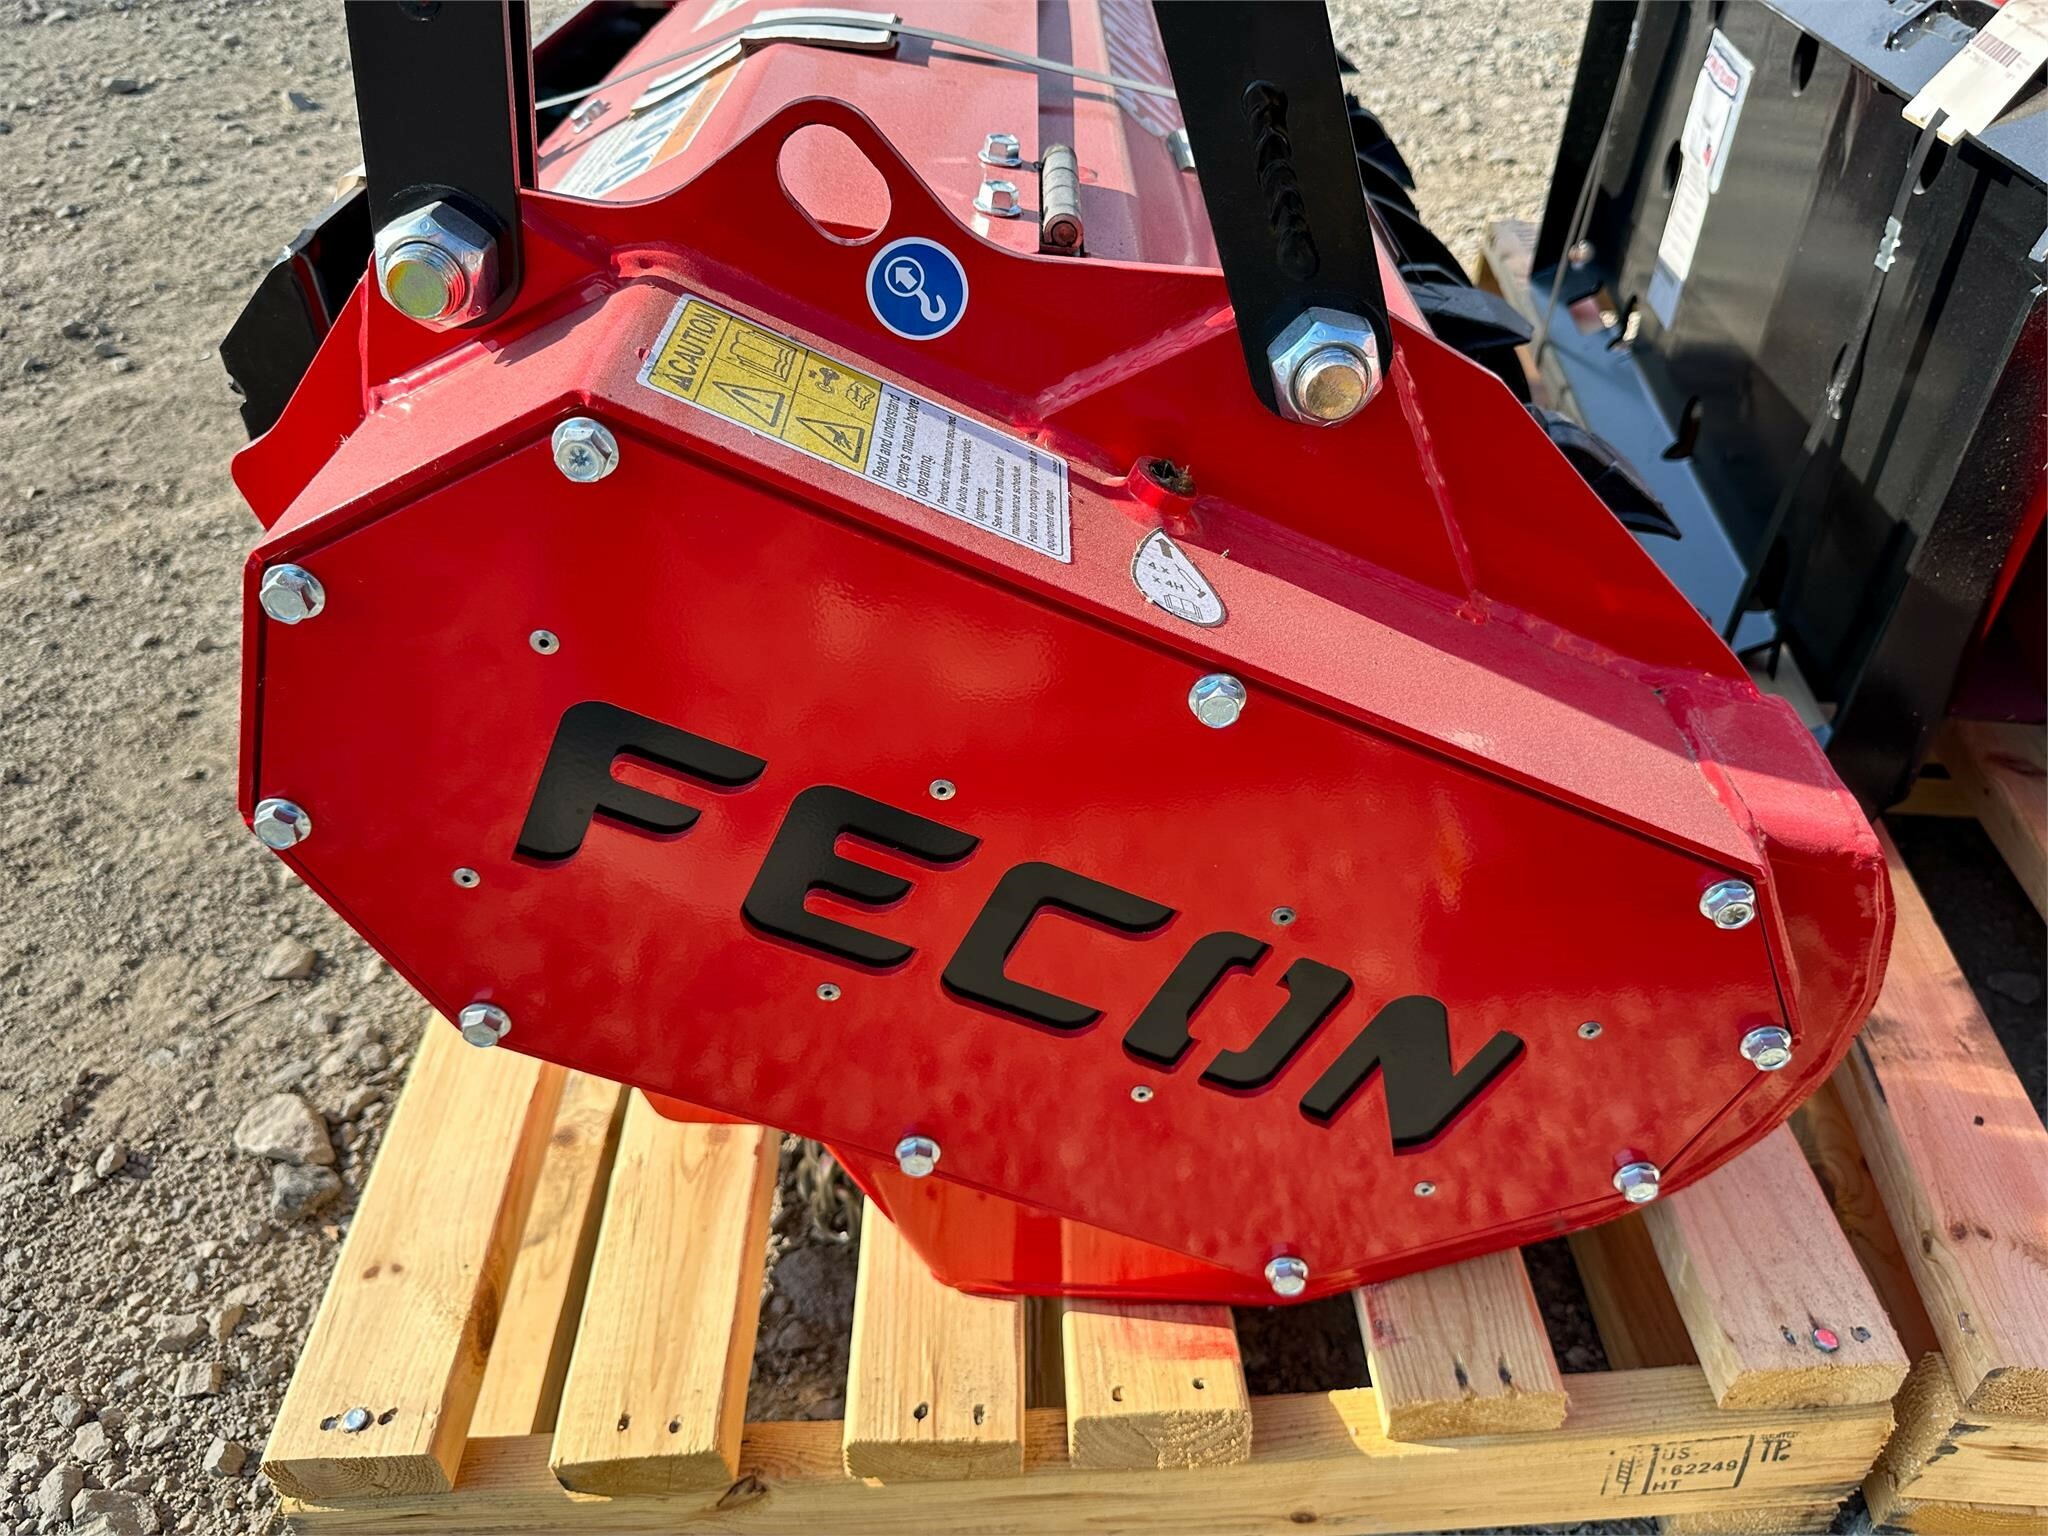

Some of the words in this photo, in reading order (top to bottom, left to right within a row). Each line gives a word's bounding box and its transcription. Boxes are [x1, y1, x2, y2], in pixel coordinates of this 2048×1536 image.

[668, 307, 721, 375] CAUTION
[882, 393, 900, 438] understand
[905, 398, 920, 425] before
[879, 436, 892, 456] and
[900, 421, 915, 454] manual
[962, 438, 972, 464] periodic
[872, 453, 889, 480] Read
[896, 453, 911, 488] owner's
[943, 438, 954, 479] maintenance
[917, 454, 936, 497] operating.
[960, 463, 971, 487] require
[994, 465, 1004, 490] manual
[937, 477, 950, 506] Periodic
[957, 485, 968, 503] bolts
[994, 487, 1003, 514] owner's
[1028, 487, 1040, 513] comply
[956, 501, 966, 514] All
[992, 513, 1003, 529] See
[1011, 493, 1021, 537] maintenance
[1028, 510, 1037, 520] to
[1027, 517, 1038, 543] Failure
[1045, 514, 1056, 551] equipment
[512, 700, 1526, 1157] FECON
[1651, 1479, 1683, 1491] HT
